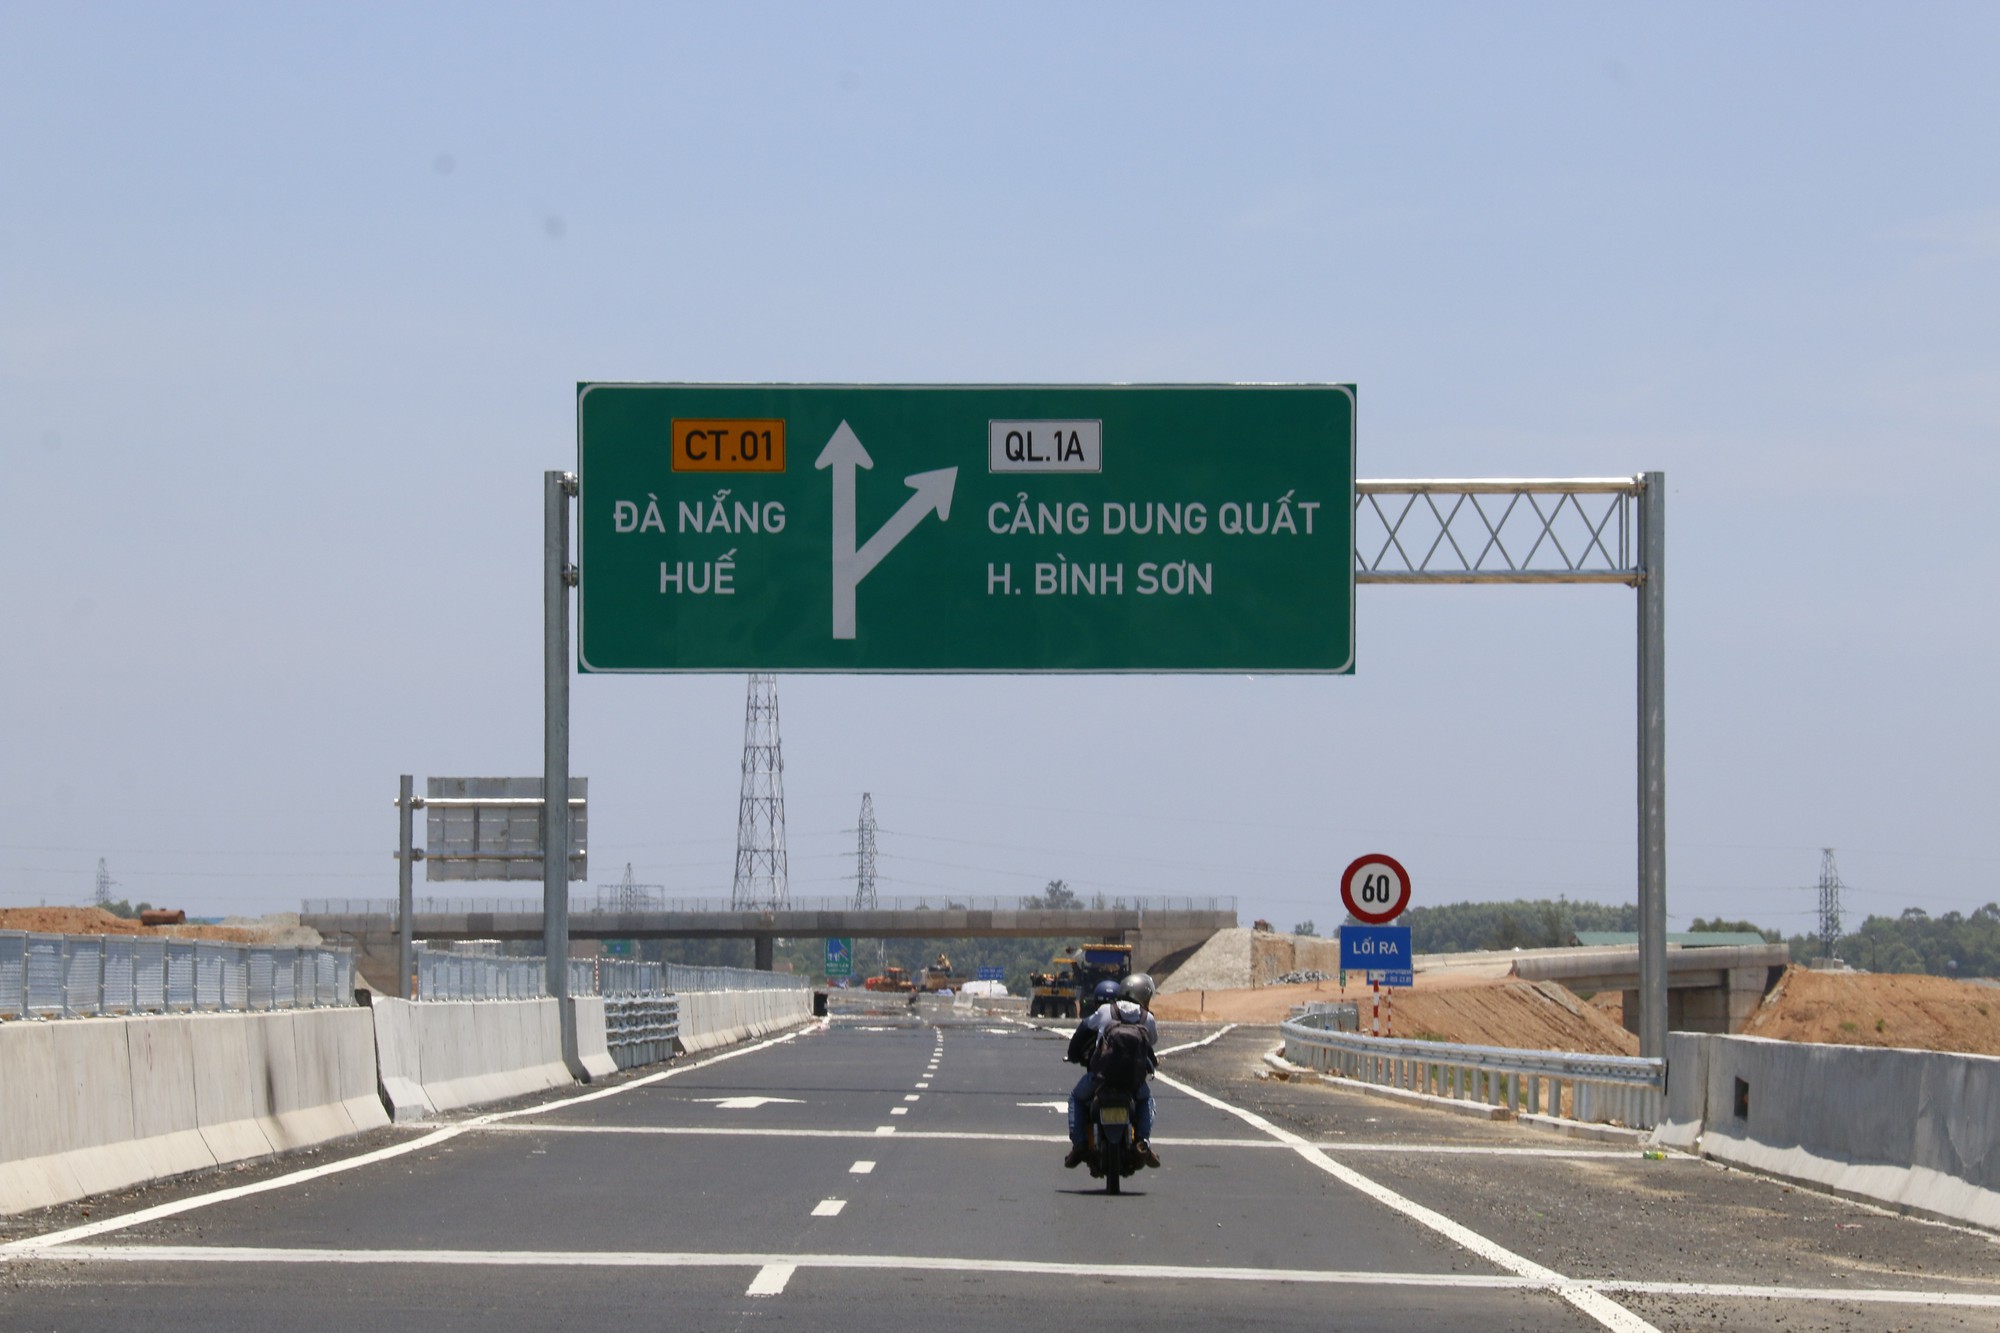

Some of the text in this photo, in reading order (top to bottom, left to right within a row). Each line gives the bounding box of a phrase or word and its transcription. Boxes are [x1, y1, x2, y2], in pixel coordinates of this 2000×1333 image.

[685, 430, 772, 462] CT.01
[1005, 430, 1084, 462] QL.1A
[613, 489, 786, 534] ĐÀ NẴNG
[988, 489, 1320, 536] CẢNG DUNG QUẤT
[660, 548, 738, 594] HUẾ
[987, 553, 1213, 596] H. BÌNH SƠN
[1362, 873, 1390, 904] 60
[1353, 936, 1398, 955] LỐI RA
